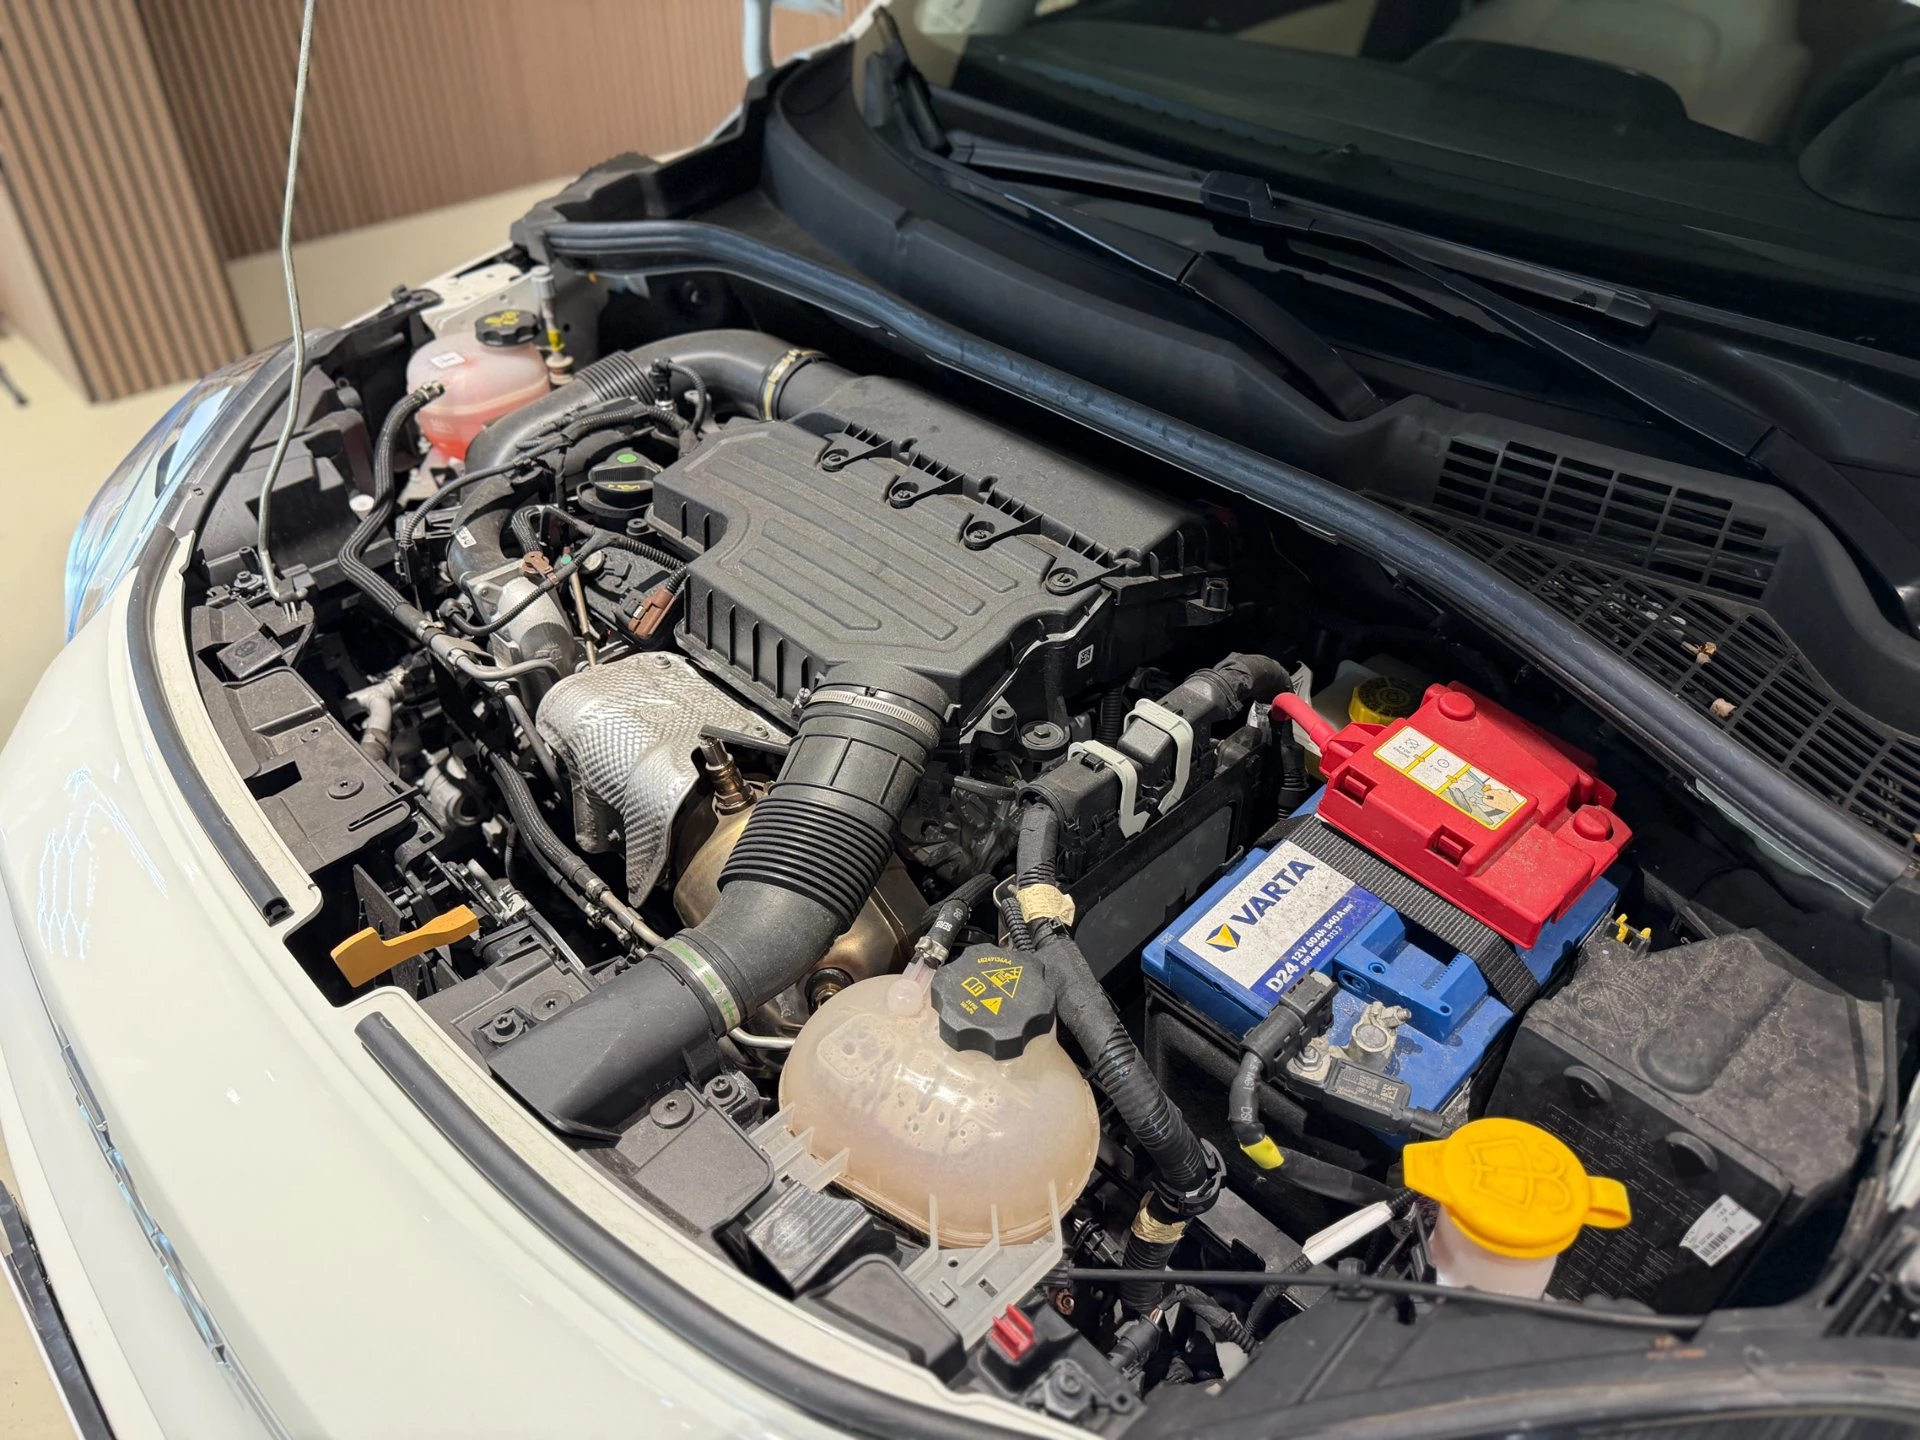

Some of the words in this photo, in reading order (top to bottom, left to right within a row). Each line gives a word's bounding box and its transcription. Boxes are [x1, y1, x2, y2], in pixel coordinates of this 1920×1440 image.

[1230, 859, 1315, 926] VARTA
[1265, 961, 1300, 993] D24
[1291, 945, 1308, 962] 12V
[1305, 929, 1327, 948] 60Ah
